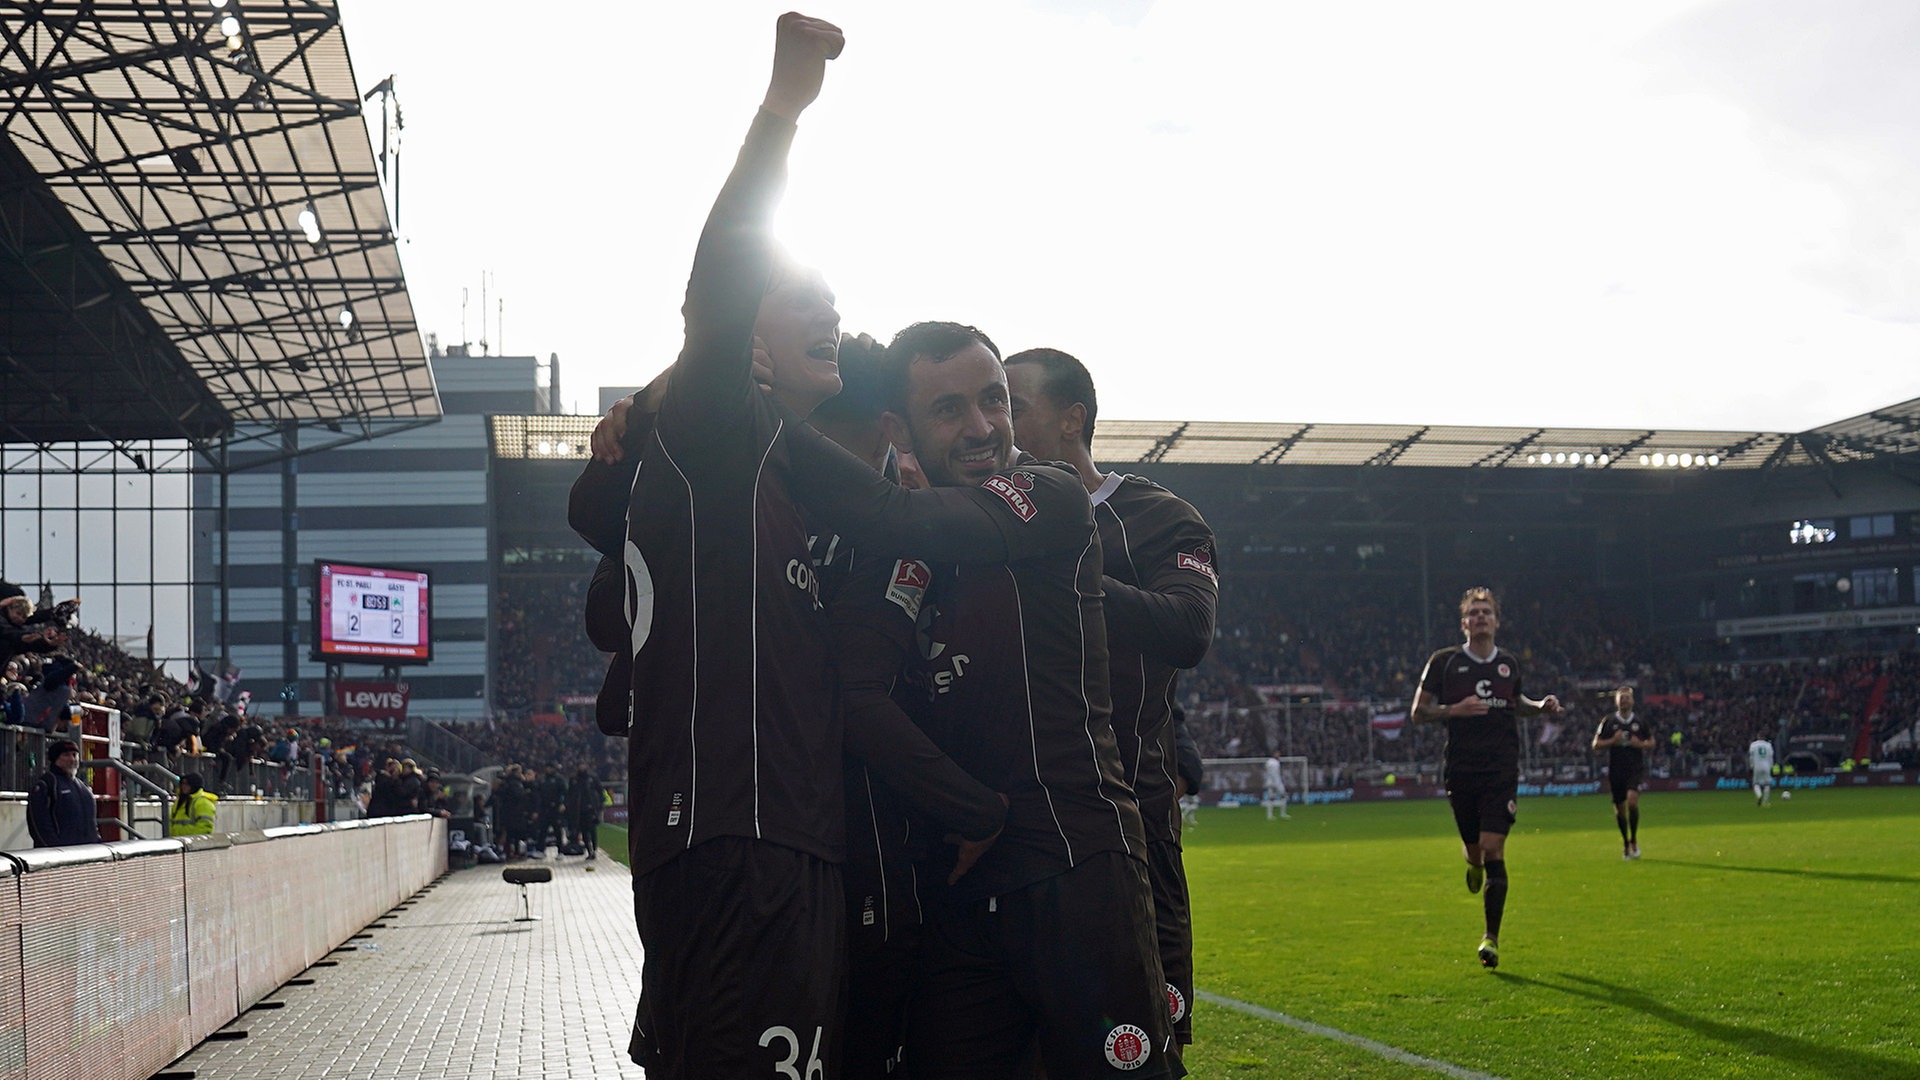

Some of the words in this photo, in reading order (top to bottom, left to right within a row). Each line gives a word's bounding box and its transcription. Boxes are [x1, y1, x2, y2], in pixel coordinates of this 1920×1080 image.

[987, 479, 1029, 516] ASTRA
[350, 614, 359, 632] 2
[393, 618, 402, 635] 2
[1106, 1040, 1114, 1052] FC
[1110, 1028, 1122, 1041] ST.
[1122, 1025, 1148, 1043] PAULI
[1121, 1058, 1141, 1069] 1910
